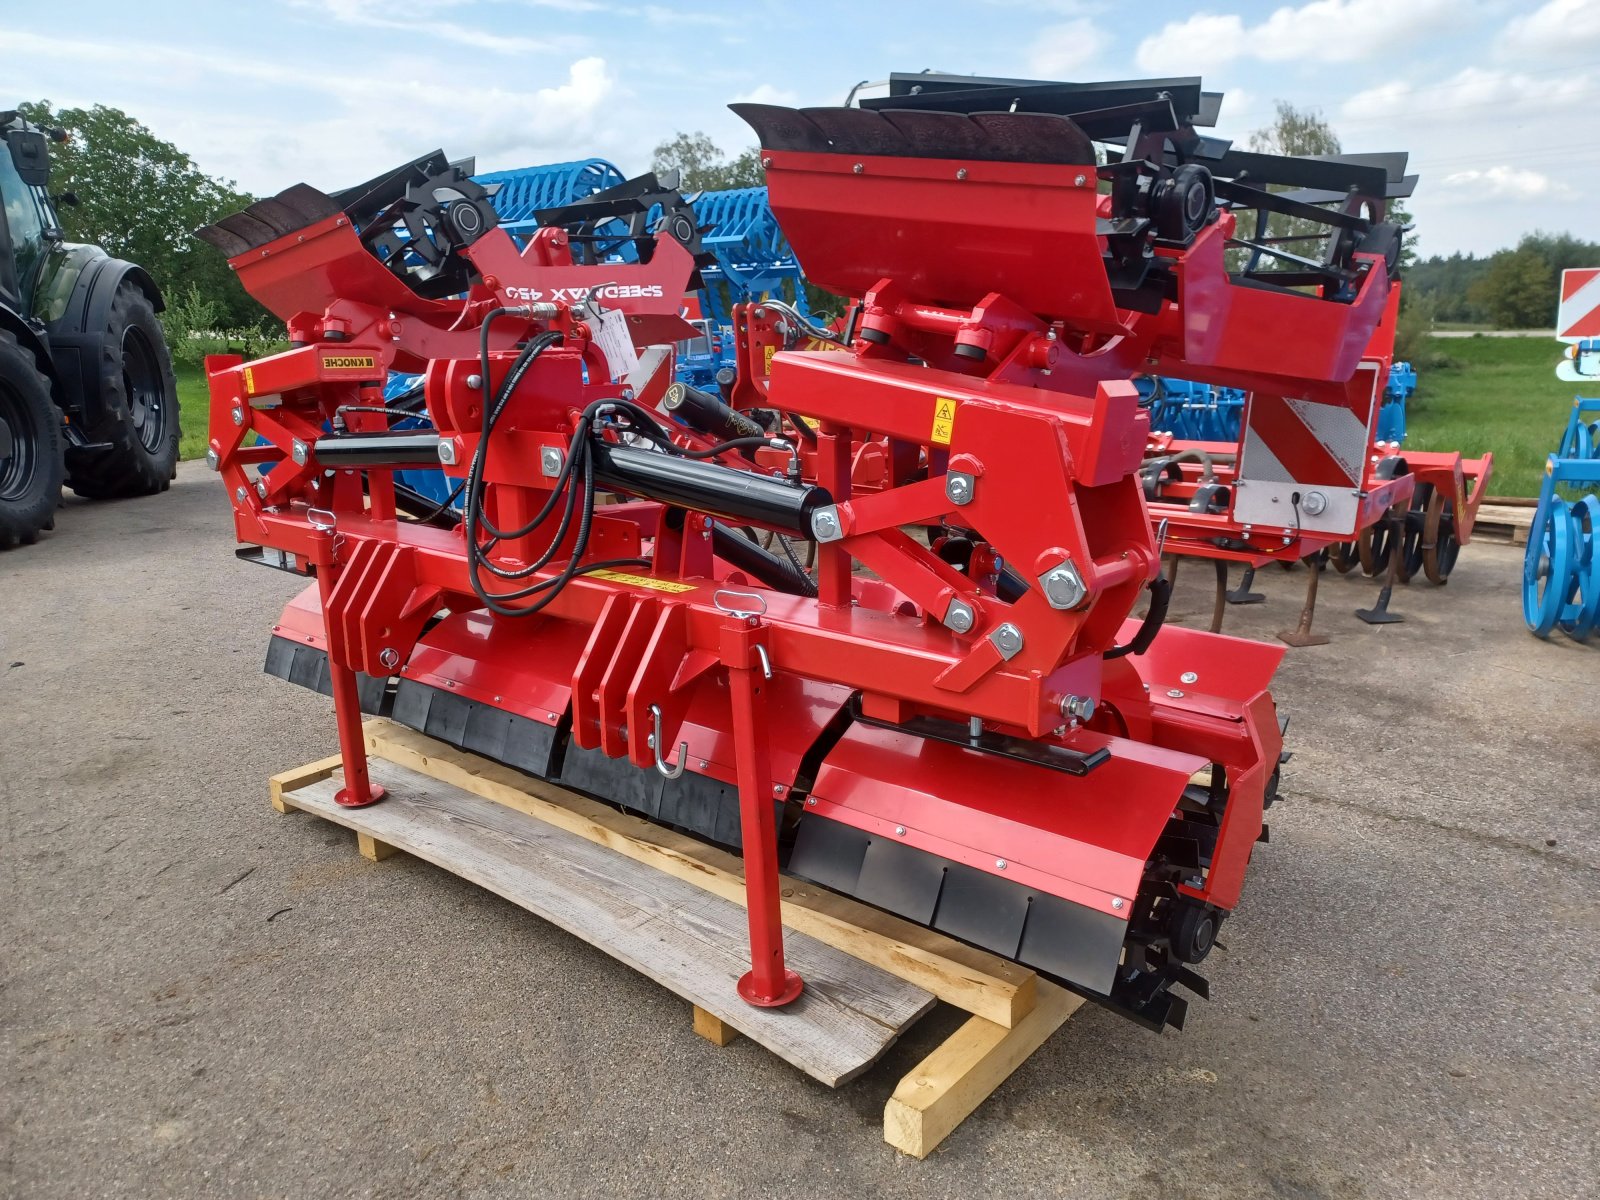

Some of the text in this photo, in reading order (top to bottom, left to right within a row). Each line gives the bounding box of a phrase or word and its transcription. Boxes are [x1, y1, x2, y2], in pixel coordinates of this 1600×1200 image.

[505, 285, 663, 301] SPEEDMAX 450
[324, 358, 364, 367] KNOCHE
